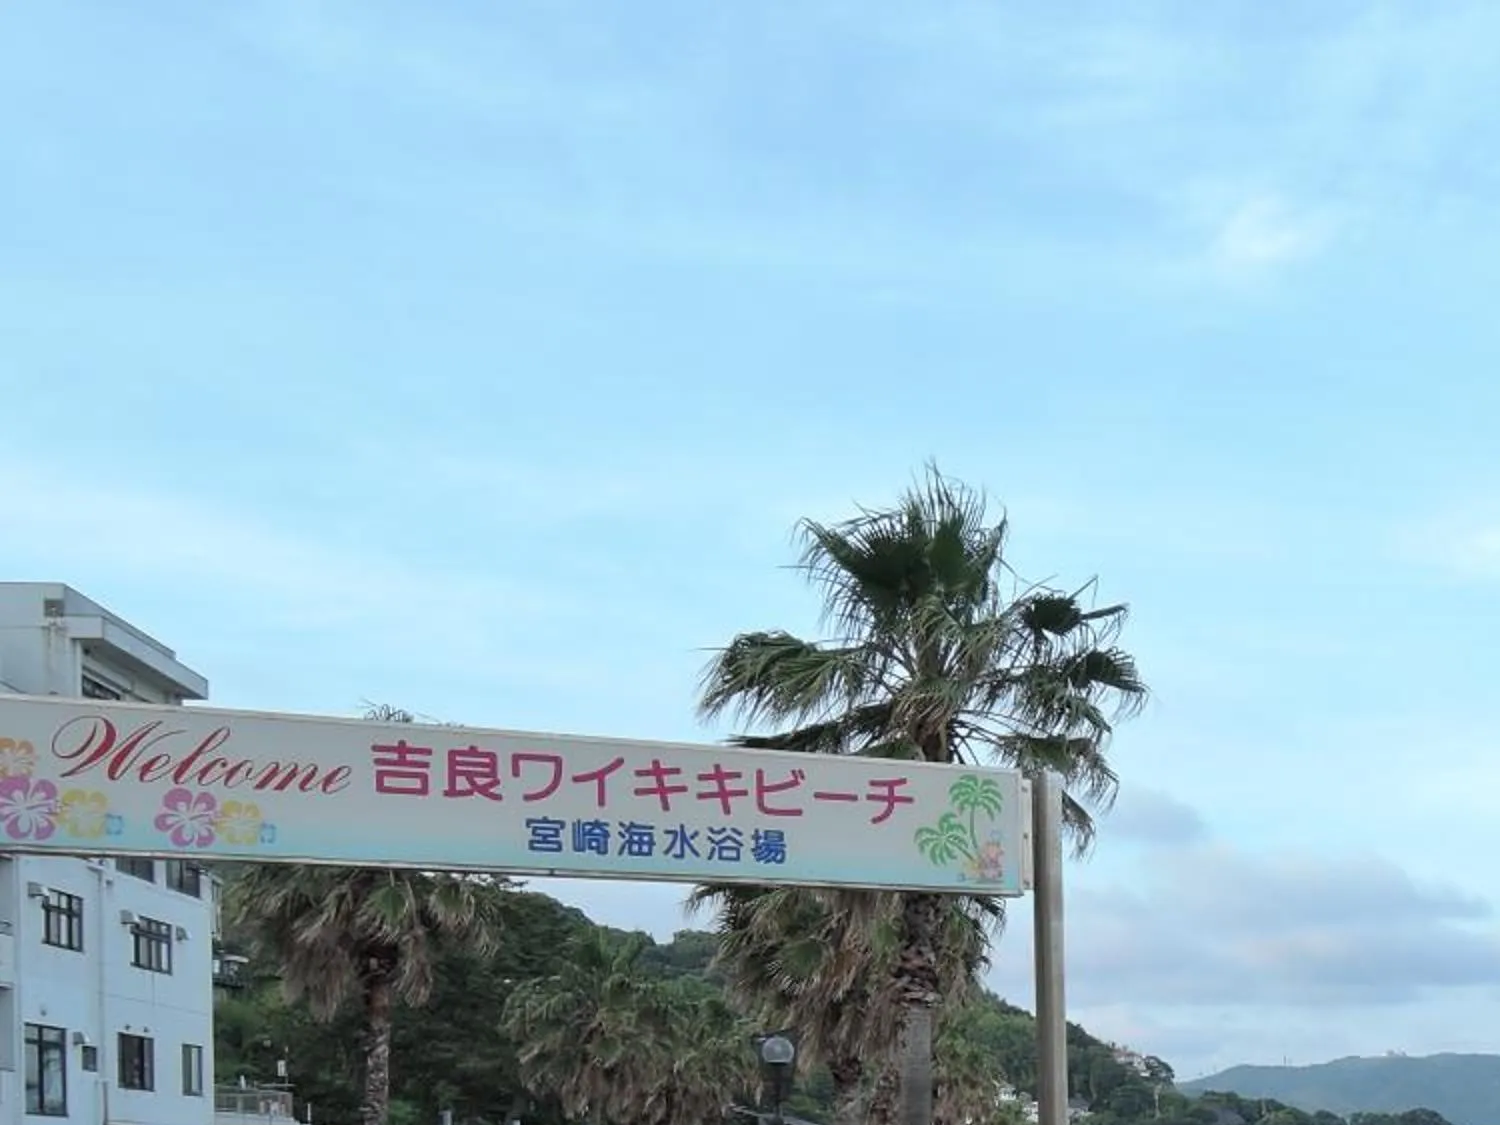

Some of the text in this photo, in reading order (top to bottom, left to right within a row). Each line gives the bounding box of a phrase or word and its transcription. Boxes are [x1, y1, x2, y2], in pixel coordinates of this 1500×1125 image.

[51, 715, 914, 825] Welcome 吉良ワイキキビーチ
[525, 816, 788, 865] 宮崎海水浴場
